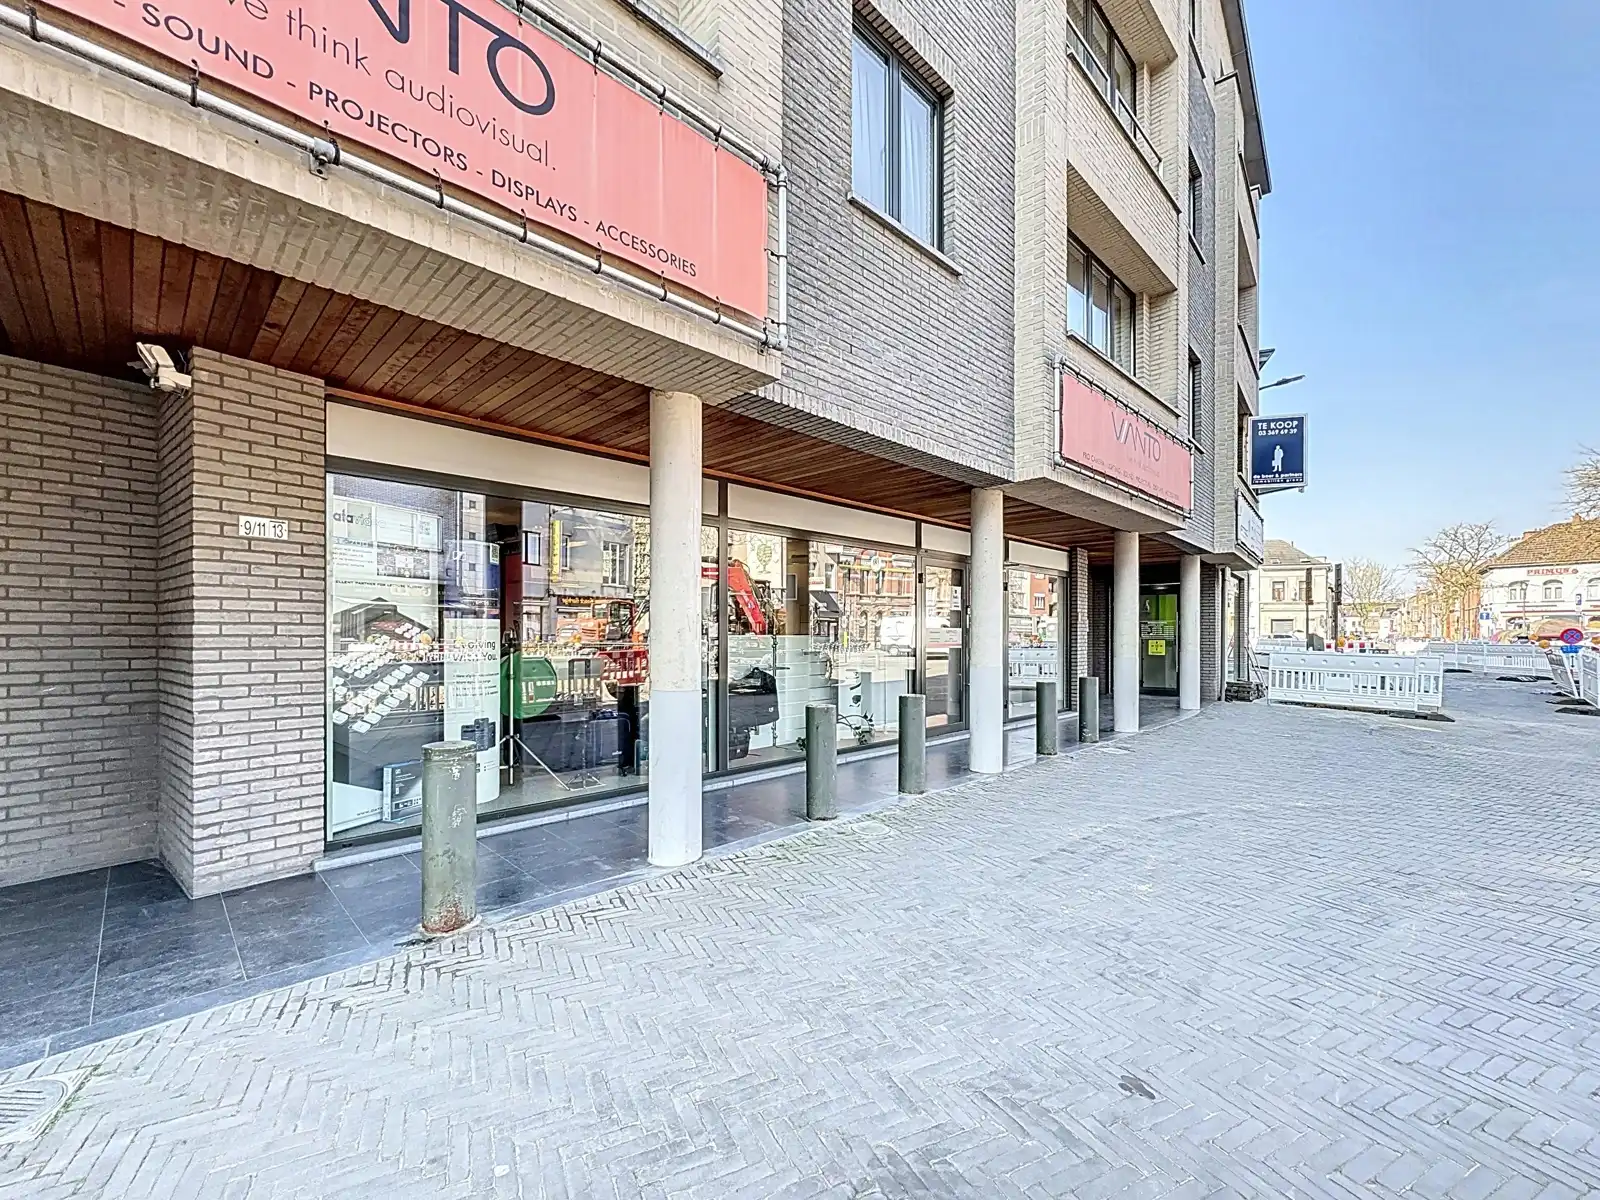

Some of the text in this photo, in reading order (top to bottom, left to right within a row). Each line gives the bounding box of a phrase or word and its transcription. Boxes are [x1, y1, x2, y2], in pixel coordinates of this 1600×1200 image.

[286, 7, 371, 77] think
[384, 69, 556, 171] audiovisual.
[141, 2, 275, 80] SOUND
[308, 81, 468, 172] PROJECTORS
[491, 168, 578, 222] DISPLAYS
[595, 220, 698, 278] ACCESSORIES
[1112, 411, 1162, 462] VANTO
[1270, 421, 1298, 429] KOOP
[244, 520, 285, 539] 9/11 13
[1527, 568, 1570, 576] PRIMUS
